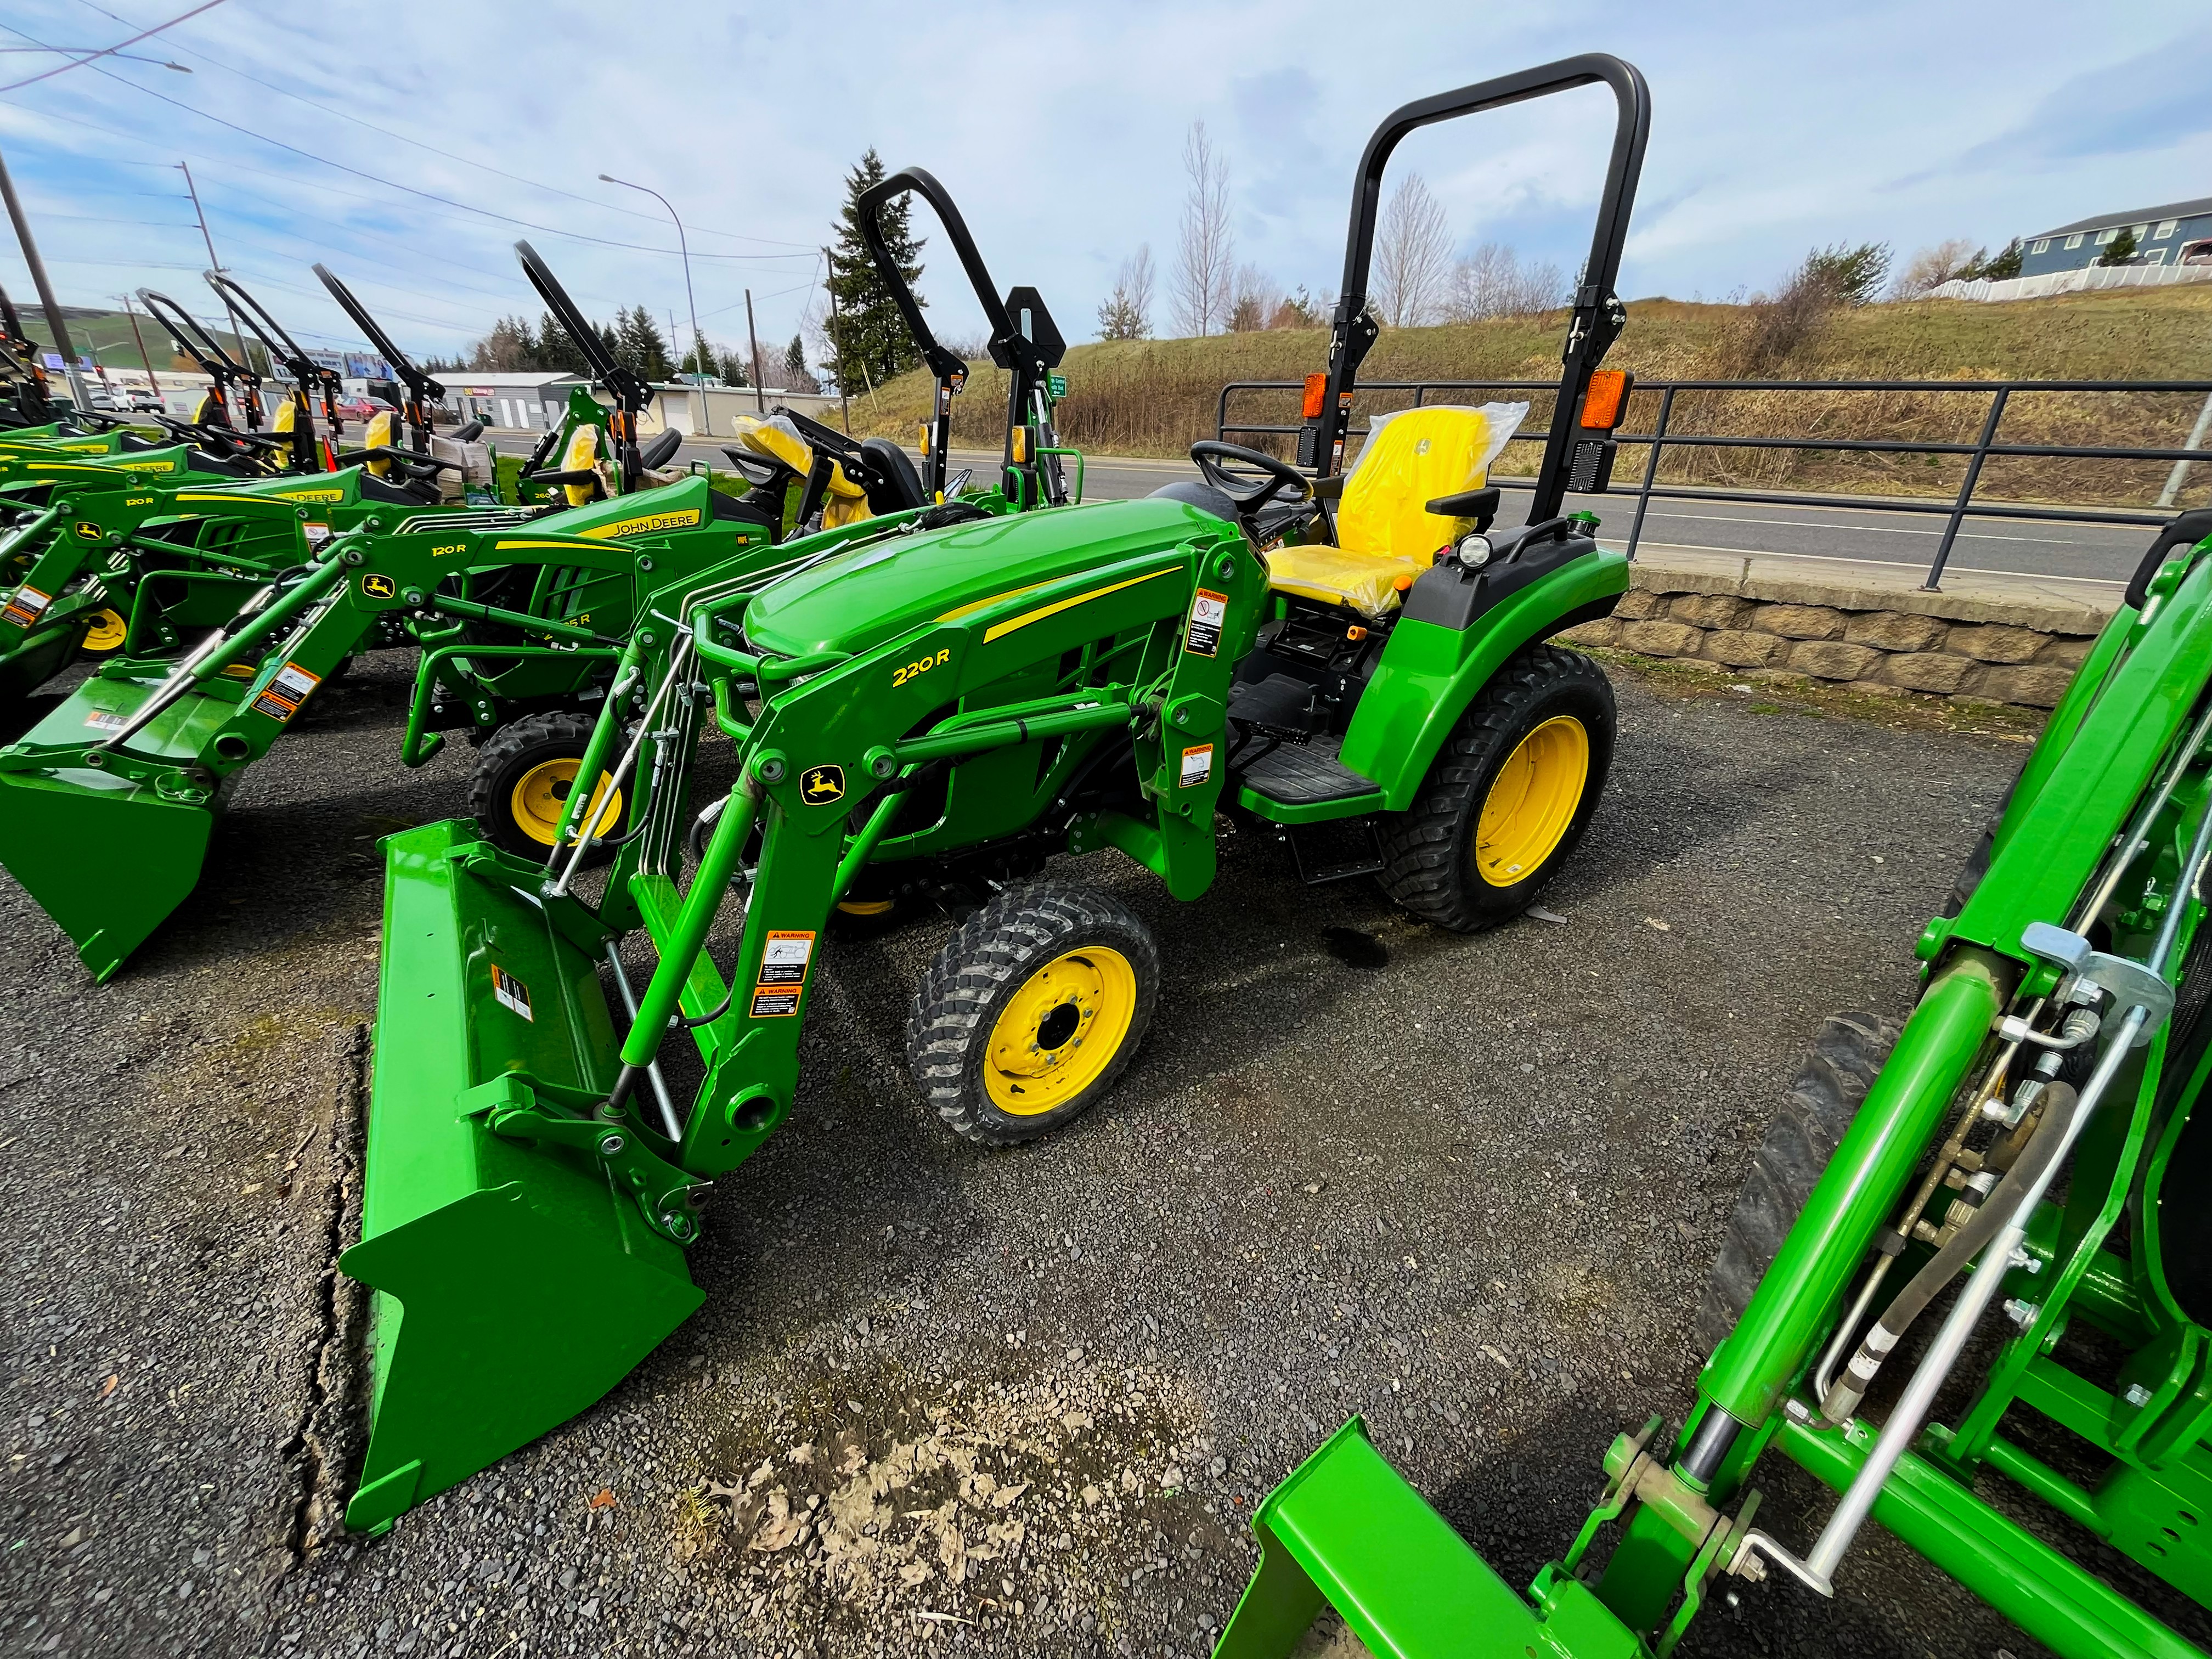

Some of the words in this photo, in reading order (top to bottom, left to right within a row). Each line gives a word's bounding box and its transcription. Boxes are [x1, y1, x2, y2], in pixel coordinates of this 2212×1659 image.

[126, 498, 145, 506] 120
[613, 521, 649, 536] JOHN
[651, 516, 694, 529] DEERE
[432, 546, 455, 557] 120
[456, 544, 466, 552] R
[1204, 590, 1227, 602] WARNING
[892, 656, 934, 689] 220
[936, 648, 950, 666] R
[1189, 745, 1212, 754] WARNING
